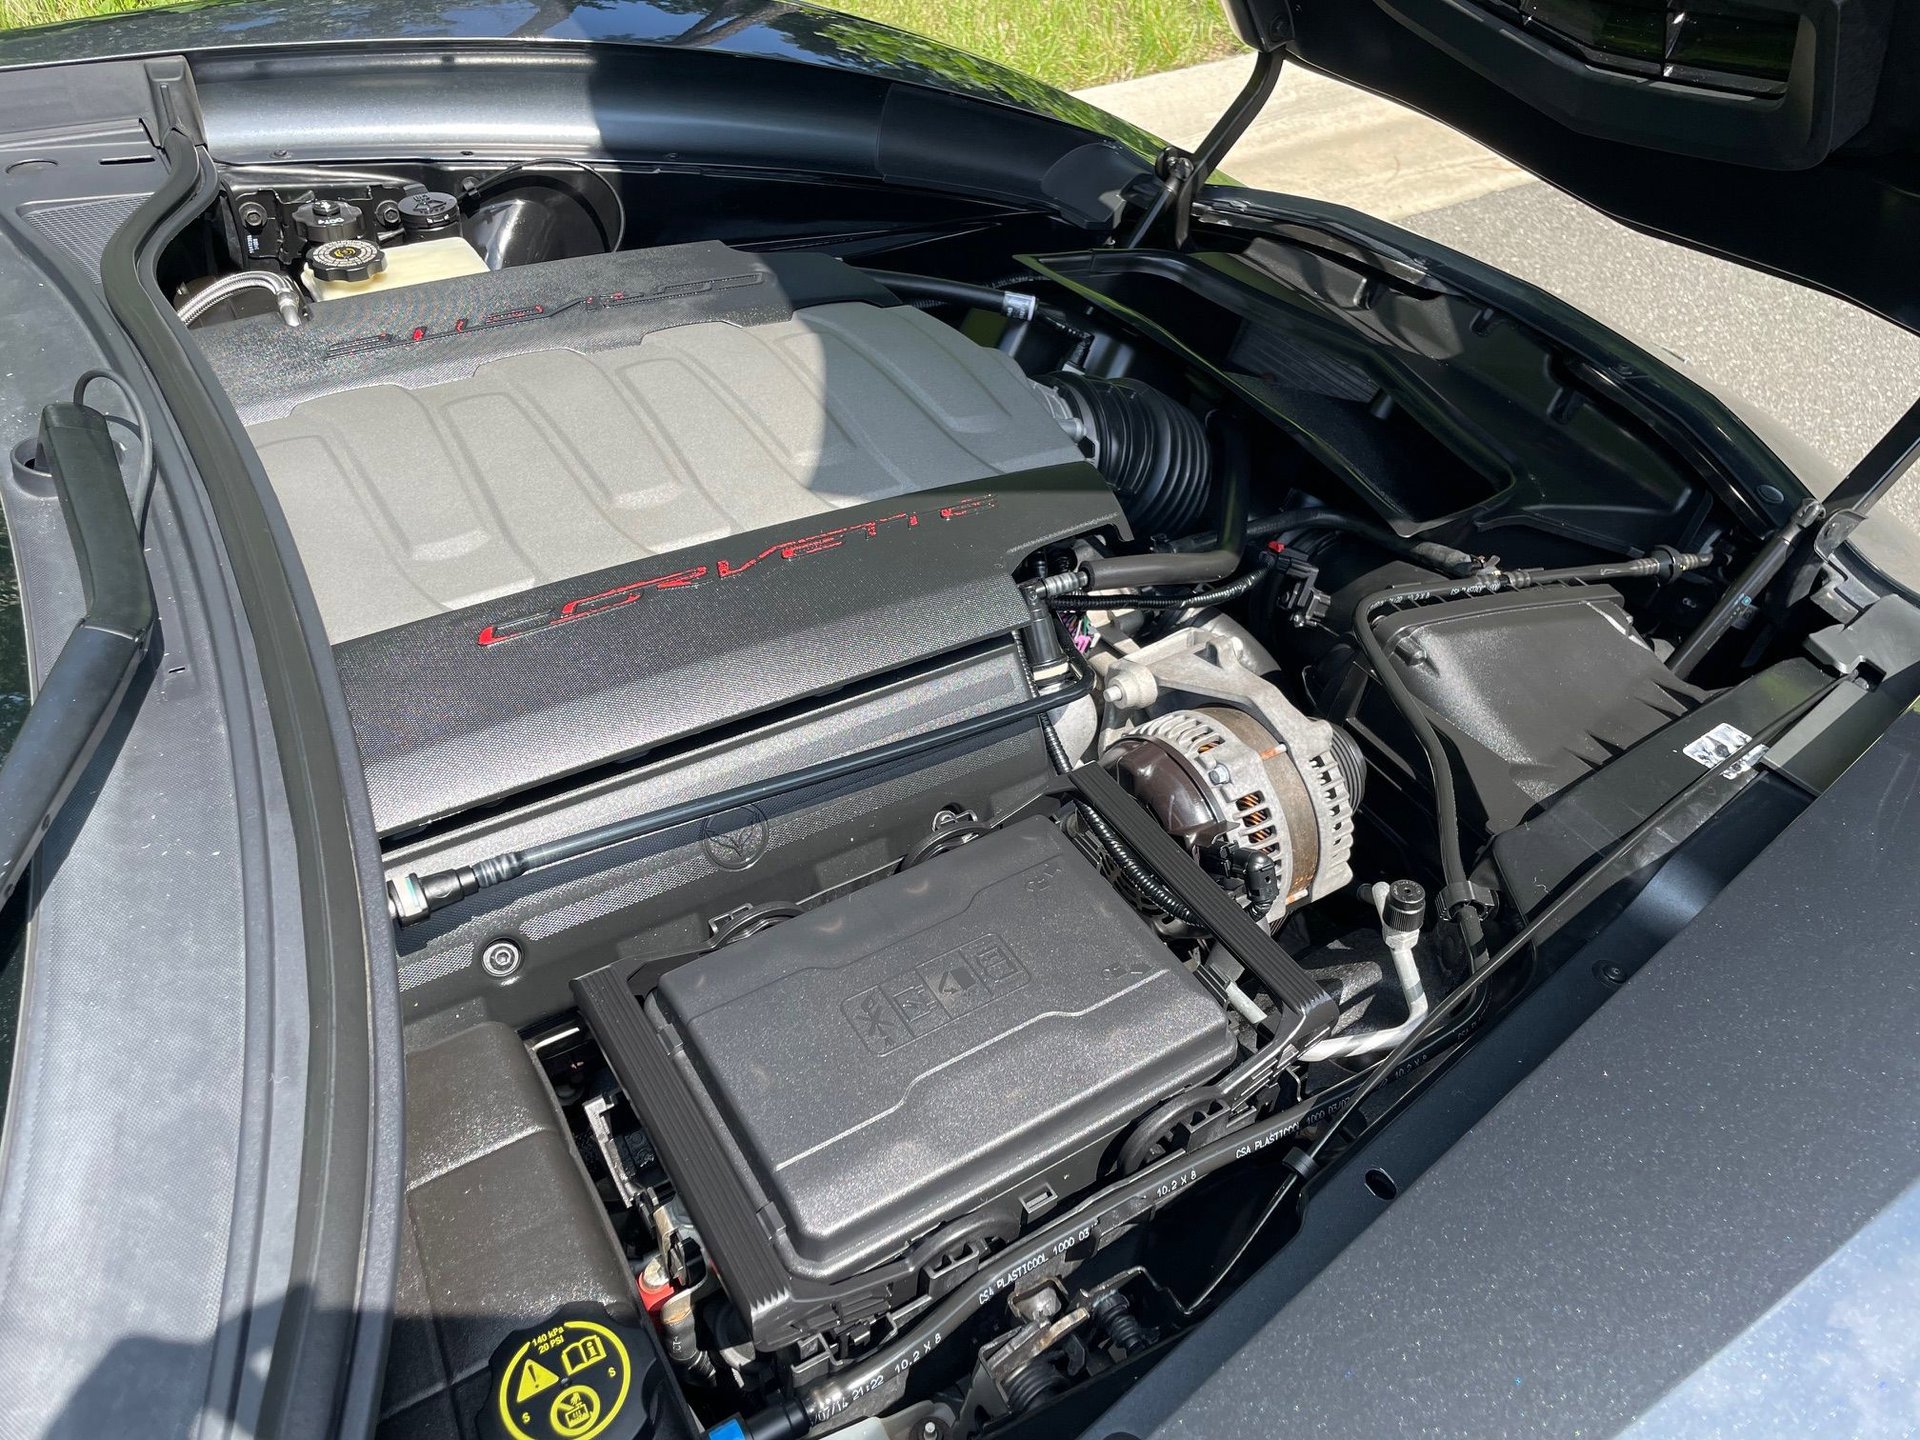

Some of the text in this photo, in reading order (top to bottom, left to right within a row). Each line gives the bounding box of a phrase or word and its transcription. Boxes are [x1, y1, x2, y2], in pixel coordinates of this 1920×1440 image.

[1235, 1144, 1252, 1160] CSA
[995, 1255, 1049, 1290] PLASTICOOL
[1052, 1236, 1075, 1255] 1000
[1156, 1181, 1178, 1198] 10.2
[1180, 1175, 1188, 1187] X
[1190, 1169, 1197, 1181] 8
[531, 1325, 565, 1348] 140 kPa
[538, 1334, 565, 1356] 20 PSI
[810, 1333, 942, 1424] /07/14 21:22 10.2 X 8
